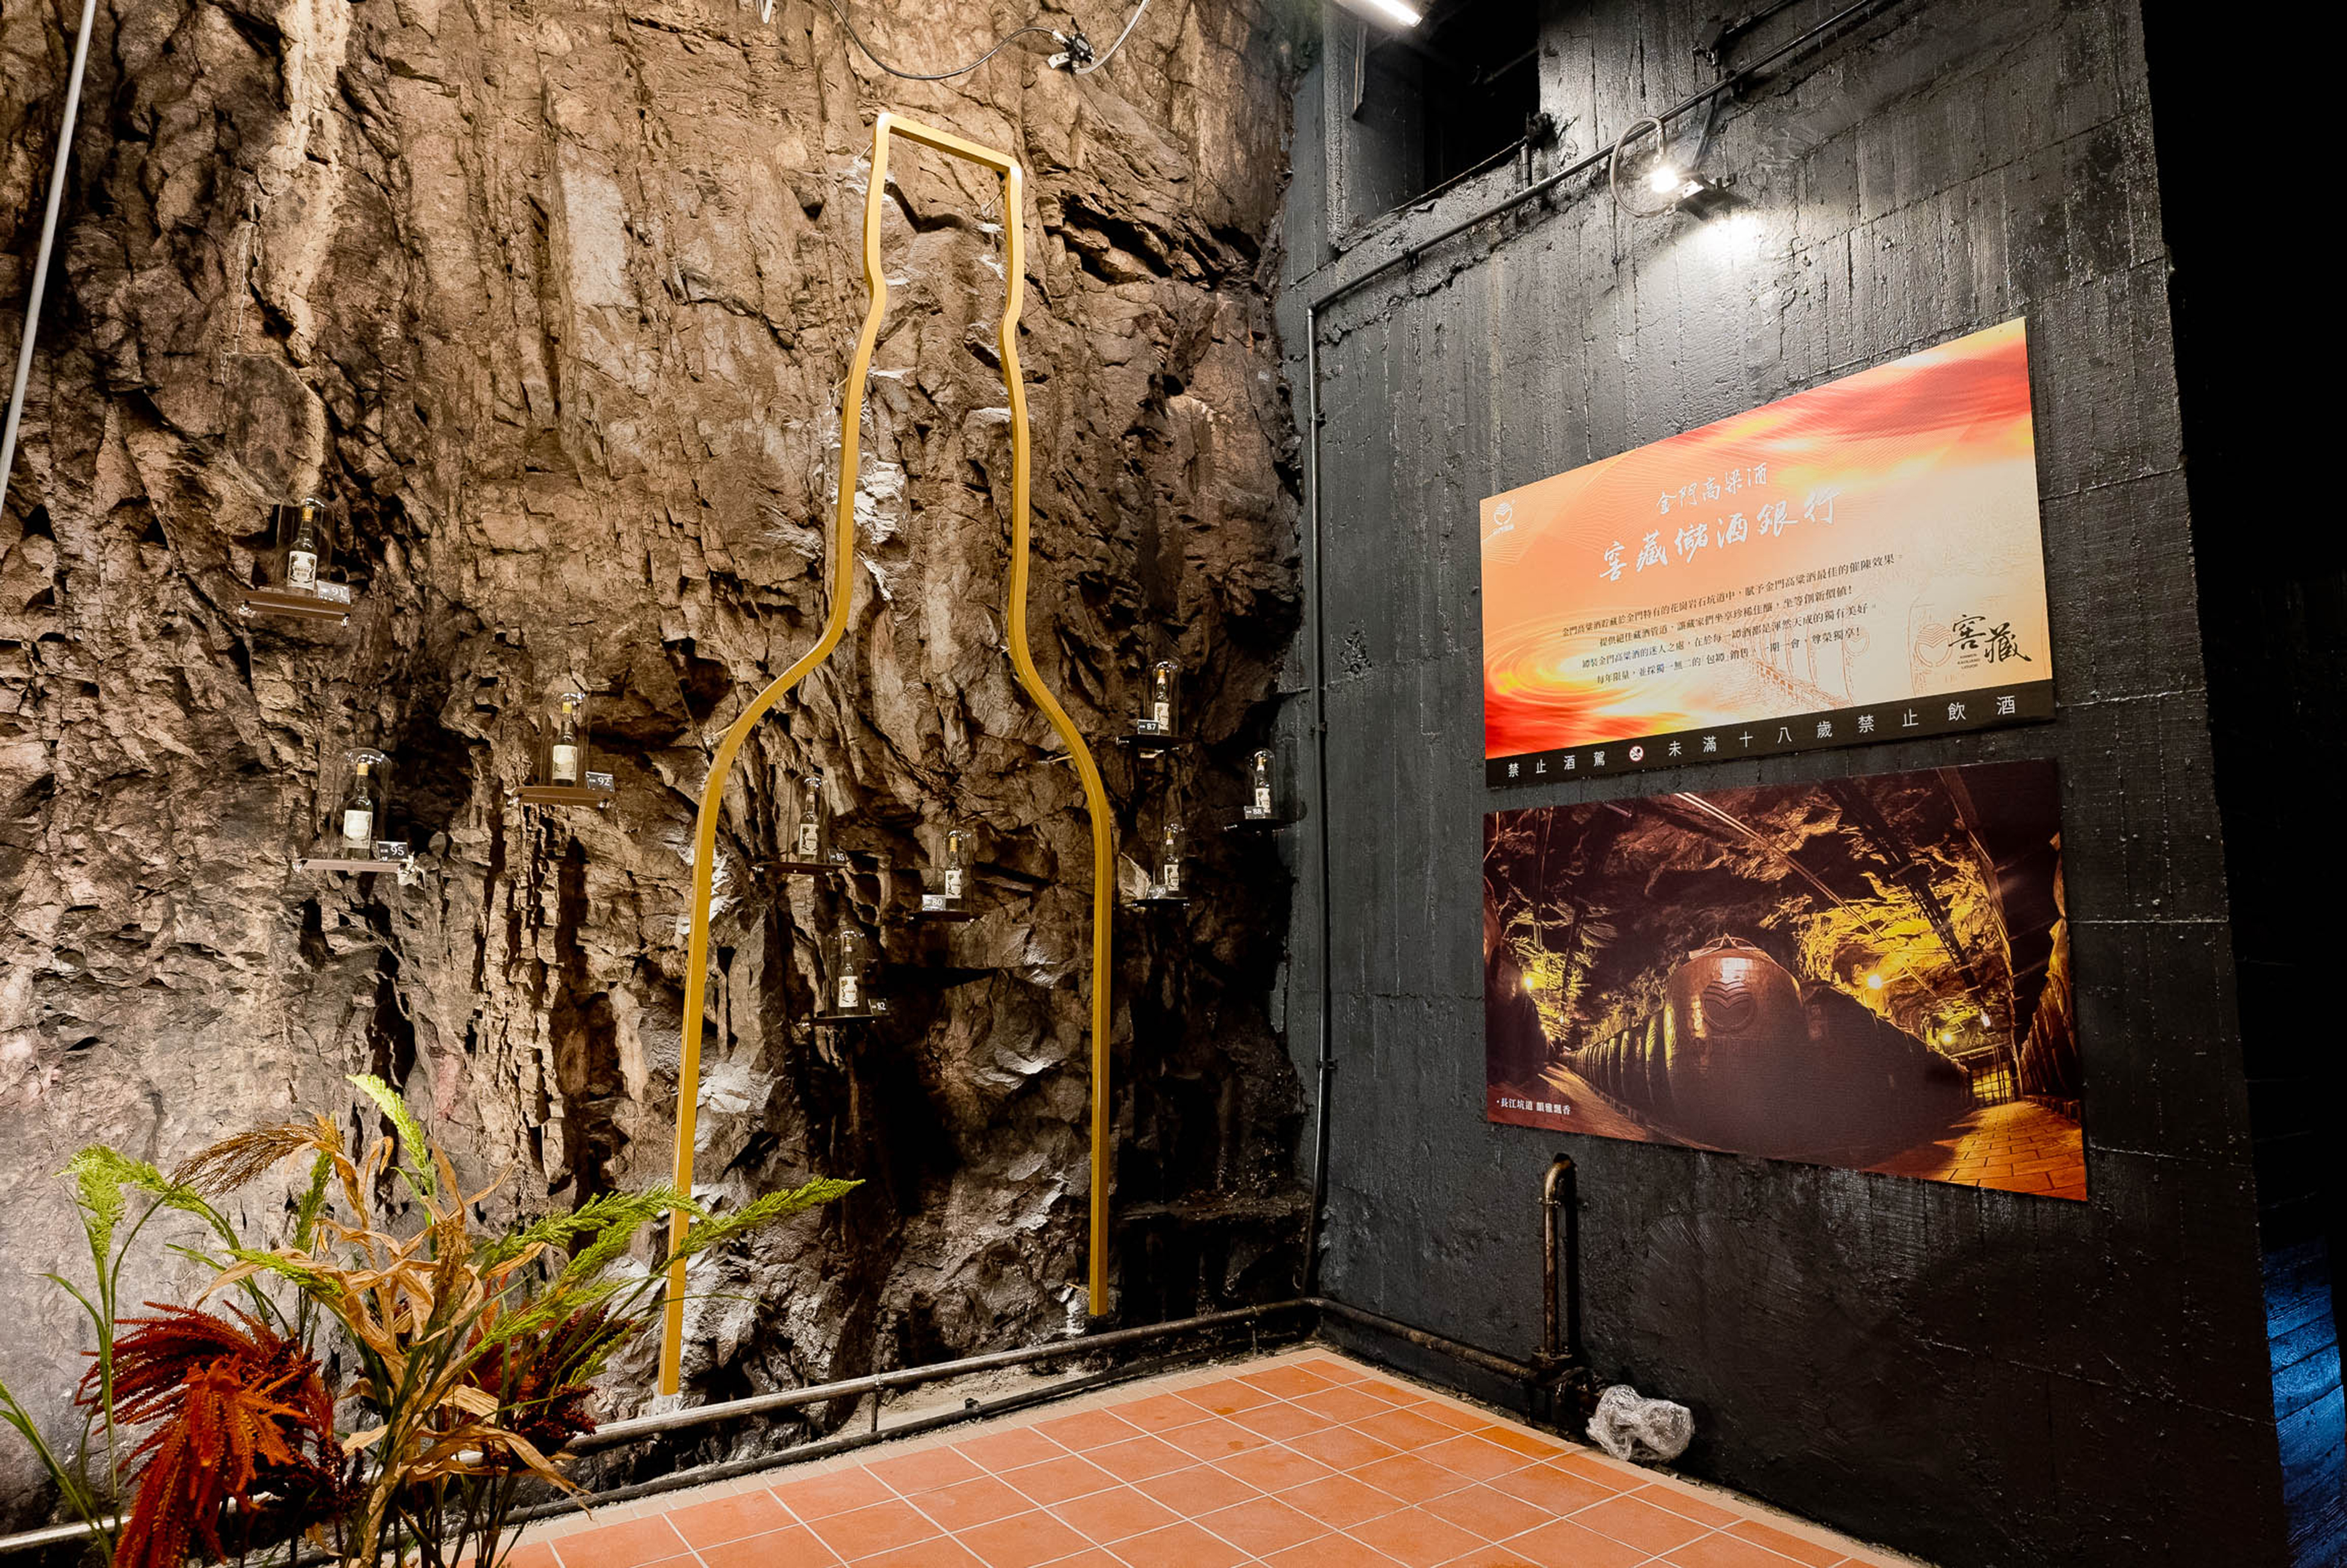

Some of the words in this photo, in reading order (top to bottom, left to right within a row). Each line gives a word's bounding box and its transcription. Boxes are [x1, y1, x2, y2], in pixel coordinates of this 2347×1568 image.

[1948, 615, 2032, 663] 窖藏
[1668, 695, 2015, 757] 未滿十八歲禁止飲酒
[1508, 751, 1605, 777] 禁止酒駕
[598, 777, 610, 786] 92
[390, 846, 405, 856] 95
[1501, 1098, 1534, 1111] 長江坑道
